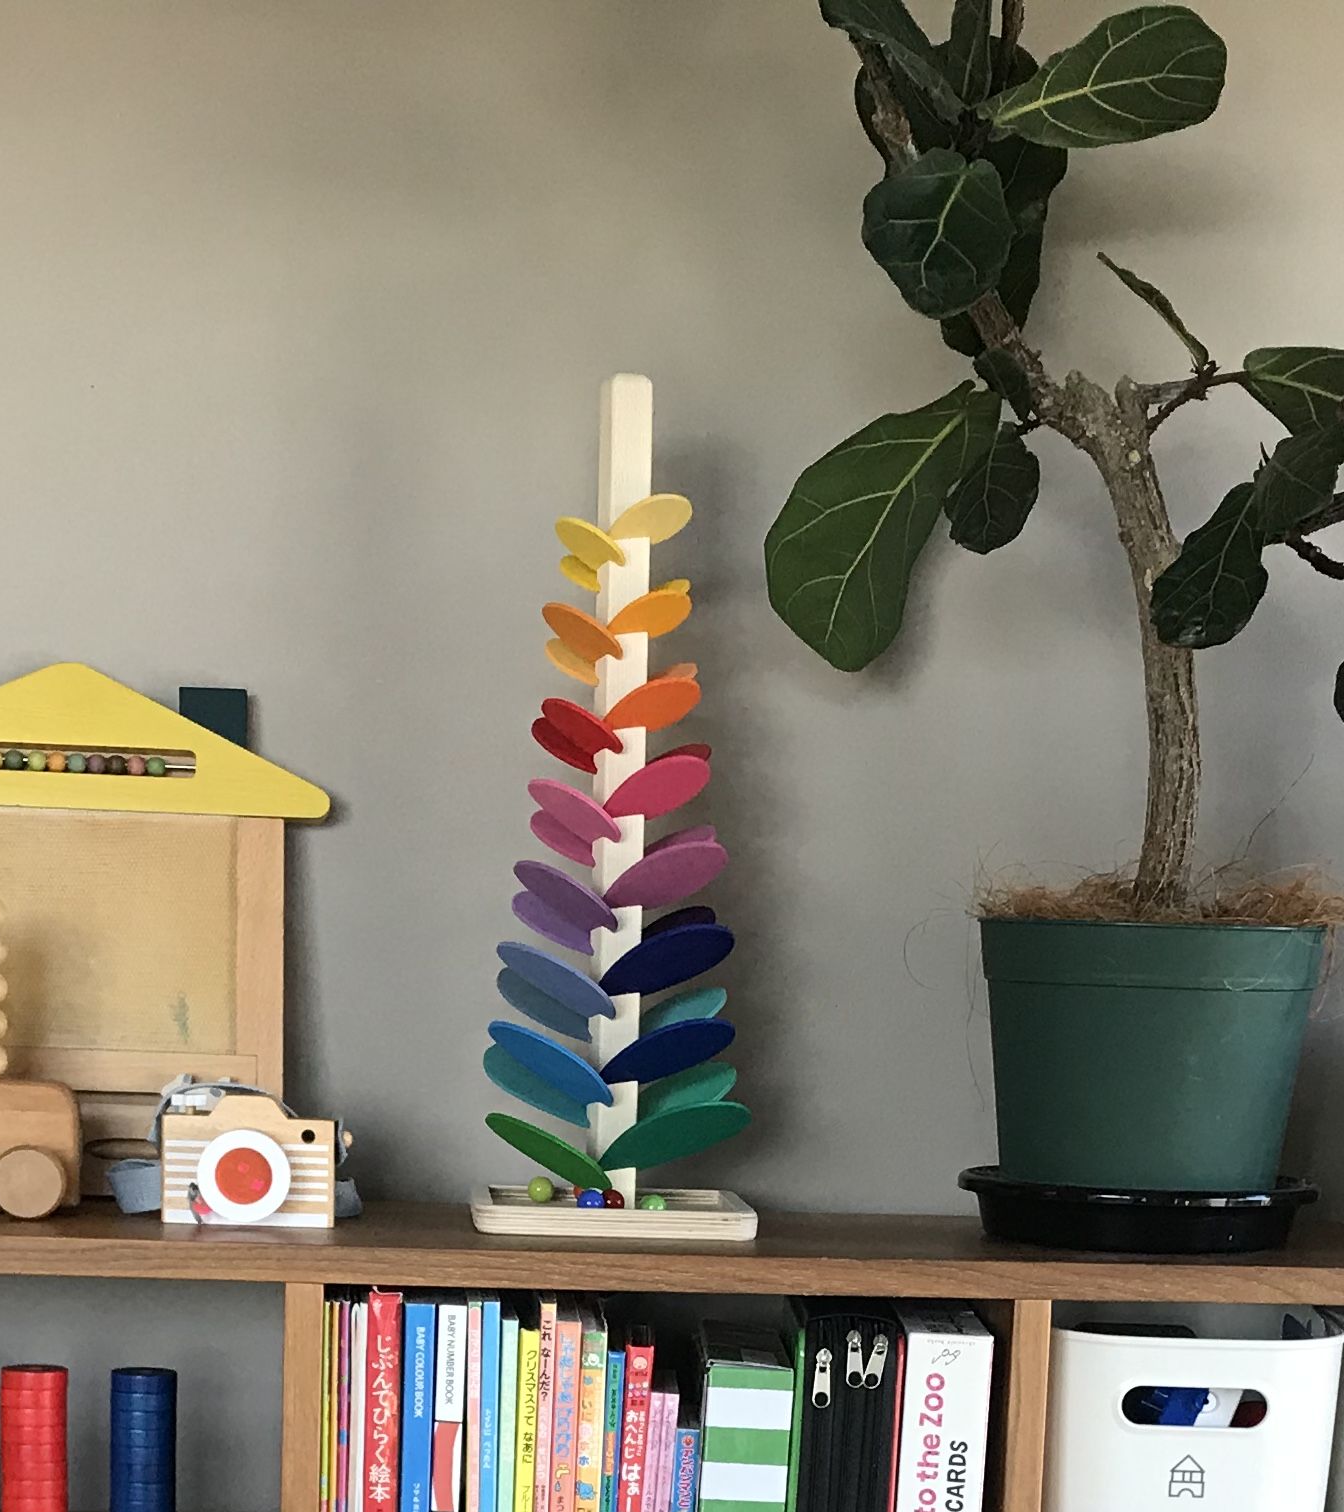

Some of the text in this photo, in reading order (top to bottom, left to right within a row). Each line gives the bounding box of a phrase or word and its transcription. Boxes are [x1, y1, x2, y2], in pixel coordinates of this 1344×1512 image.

[413, 1326, 426, 1418] BABY COLOUR BOOK
[444, 1314, 456, 1405] BABY NUMBER BOOK
[539, 1320, 552, 1401] これ なーんだ?
[918, 1372, 946, 1428] Zoo
[522, 1350, 537, 1464] クリスマスって なあに
[916, 1433, 941, 1483] the
[944, 1439, 969, 1512] CARDS
